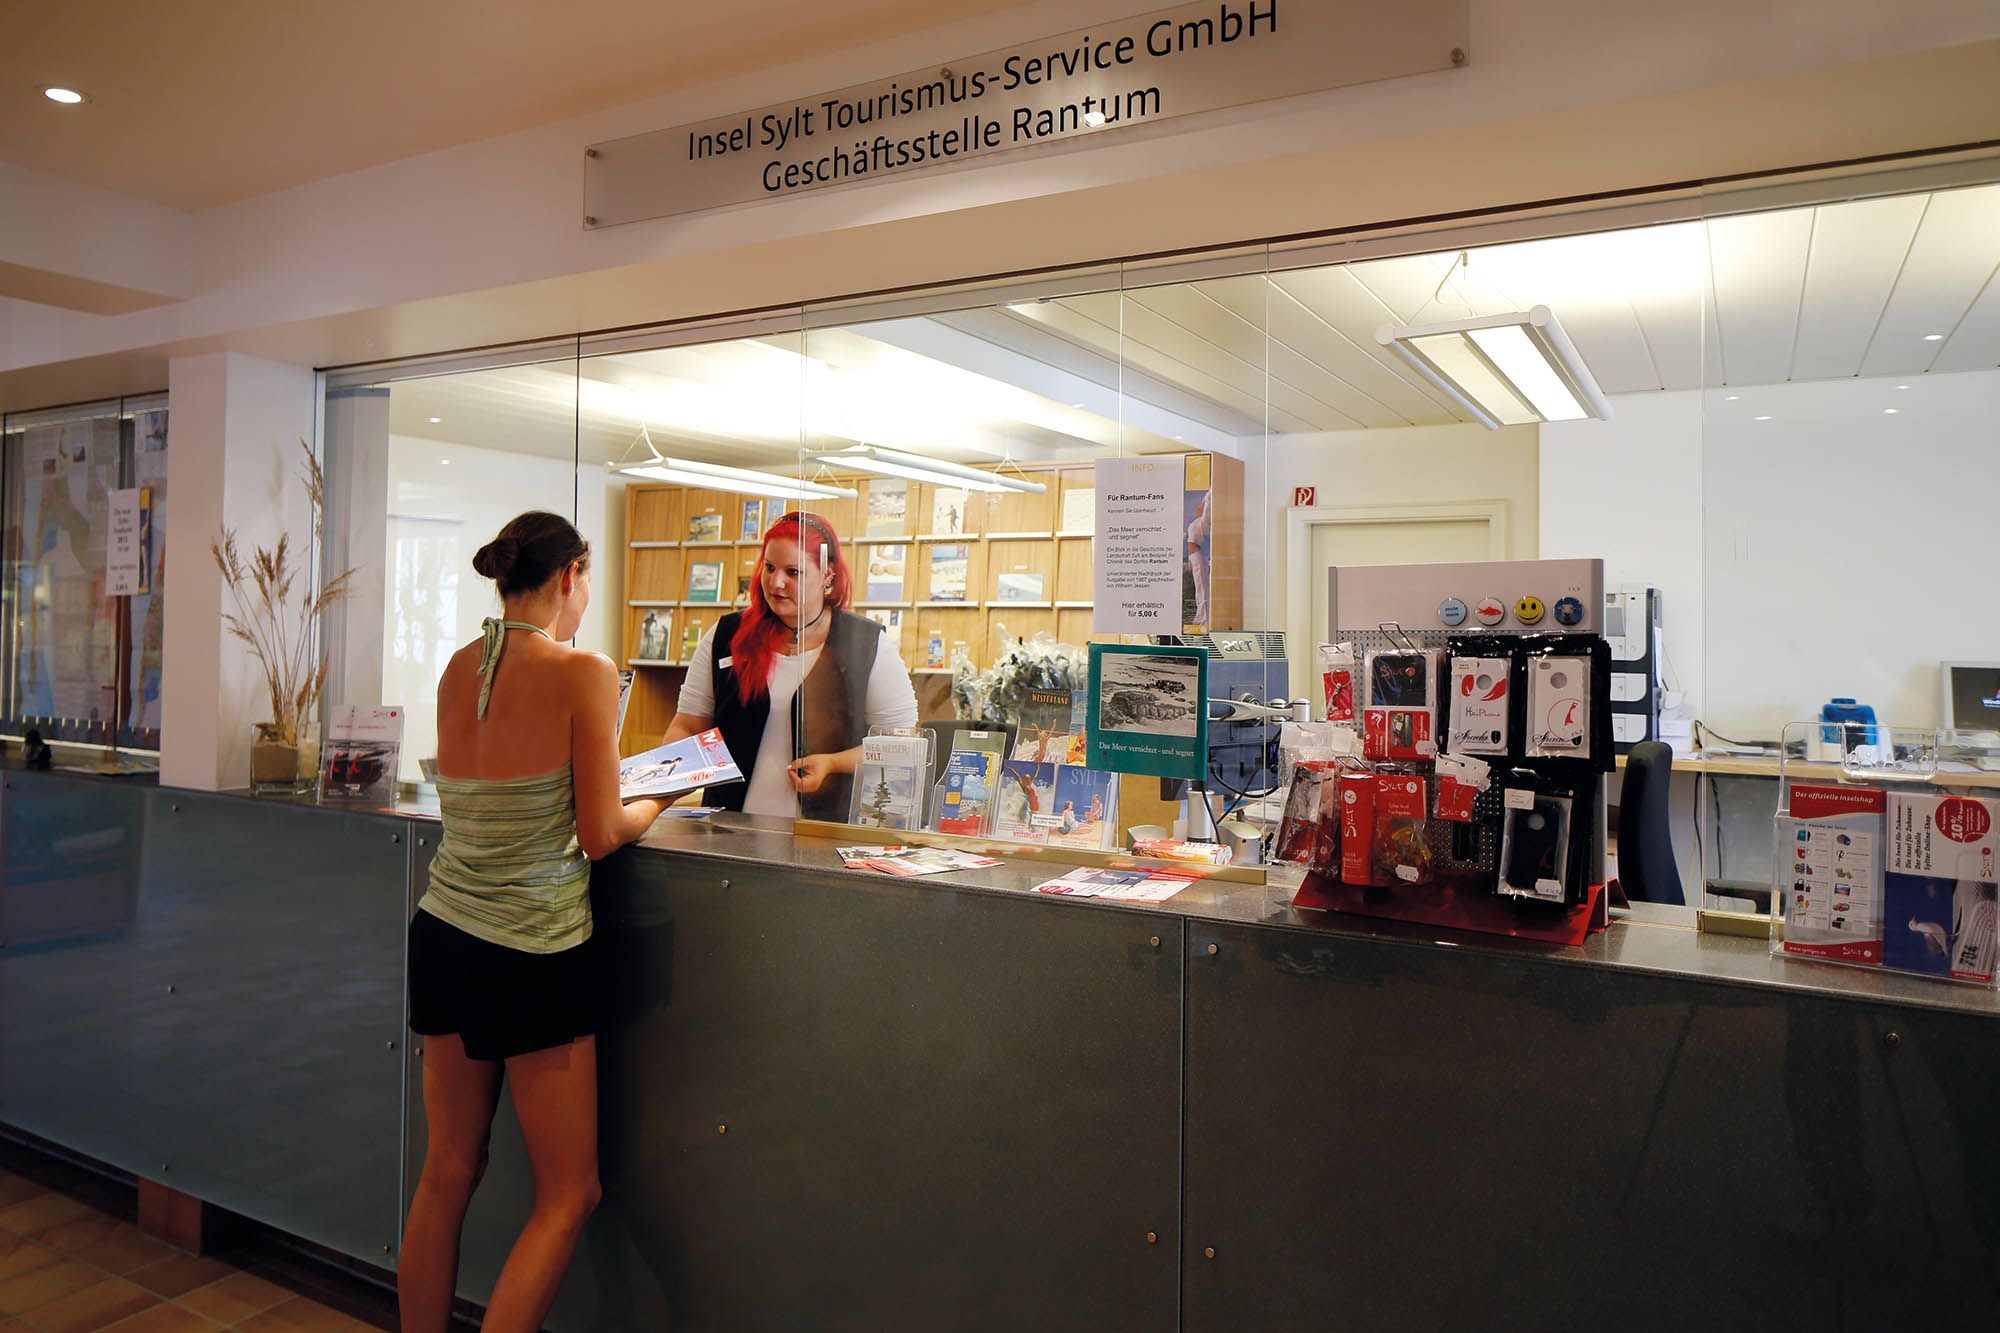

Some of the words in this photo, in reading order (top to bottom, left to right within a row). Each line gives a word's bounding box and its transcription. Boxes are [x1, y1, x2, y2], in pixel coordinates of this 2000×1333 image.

[689, 118, 751, 160] Insel
[760, 106, 814, 150] Sylt
[821, 35, 1135, 131] Tourismus-Service
[1146, 0, 1277, 56] GmbH
[763, 115, 1001, 191] Geschäftsstelle
[1013, 85, 1161, 142] Rantum
[1120, 493, 1165, 501] Rantum-Fans
[1222, 640, 1252, 653] acer
[1099, 741, 1110, 750] Das
[1111, 743, 1127, 751] Meer
[1128, 745, 1158, 754] vernichtet
[1071, 768, 1098, 785] SYLT
[1808, 792, 1839, 801] offizielle
[1839, 795, 1874, 804] Inselshop
[1924, 815, 1932, 852] Online-Shop
[1950, 815, 1964, 840] 10%
[1905, 832, 1913, 842] für
[1914, 833, 1922, 858] offizielle
[1924, 853, 1932, 871] Sylter
